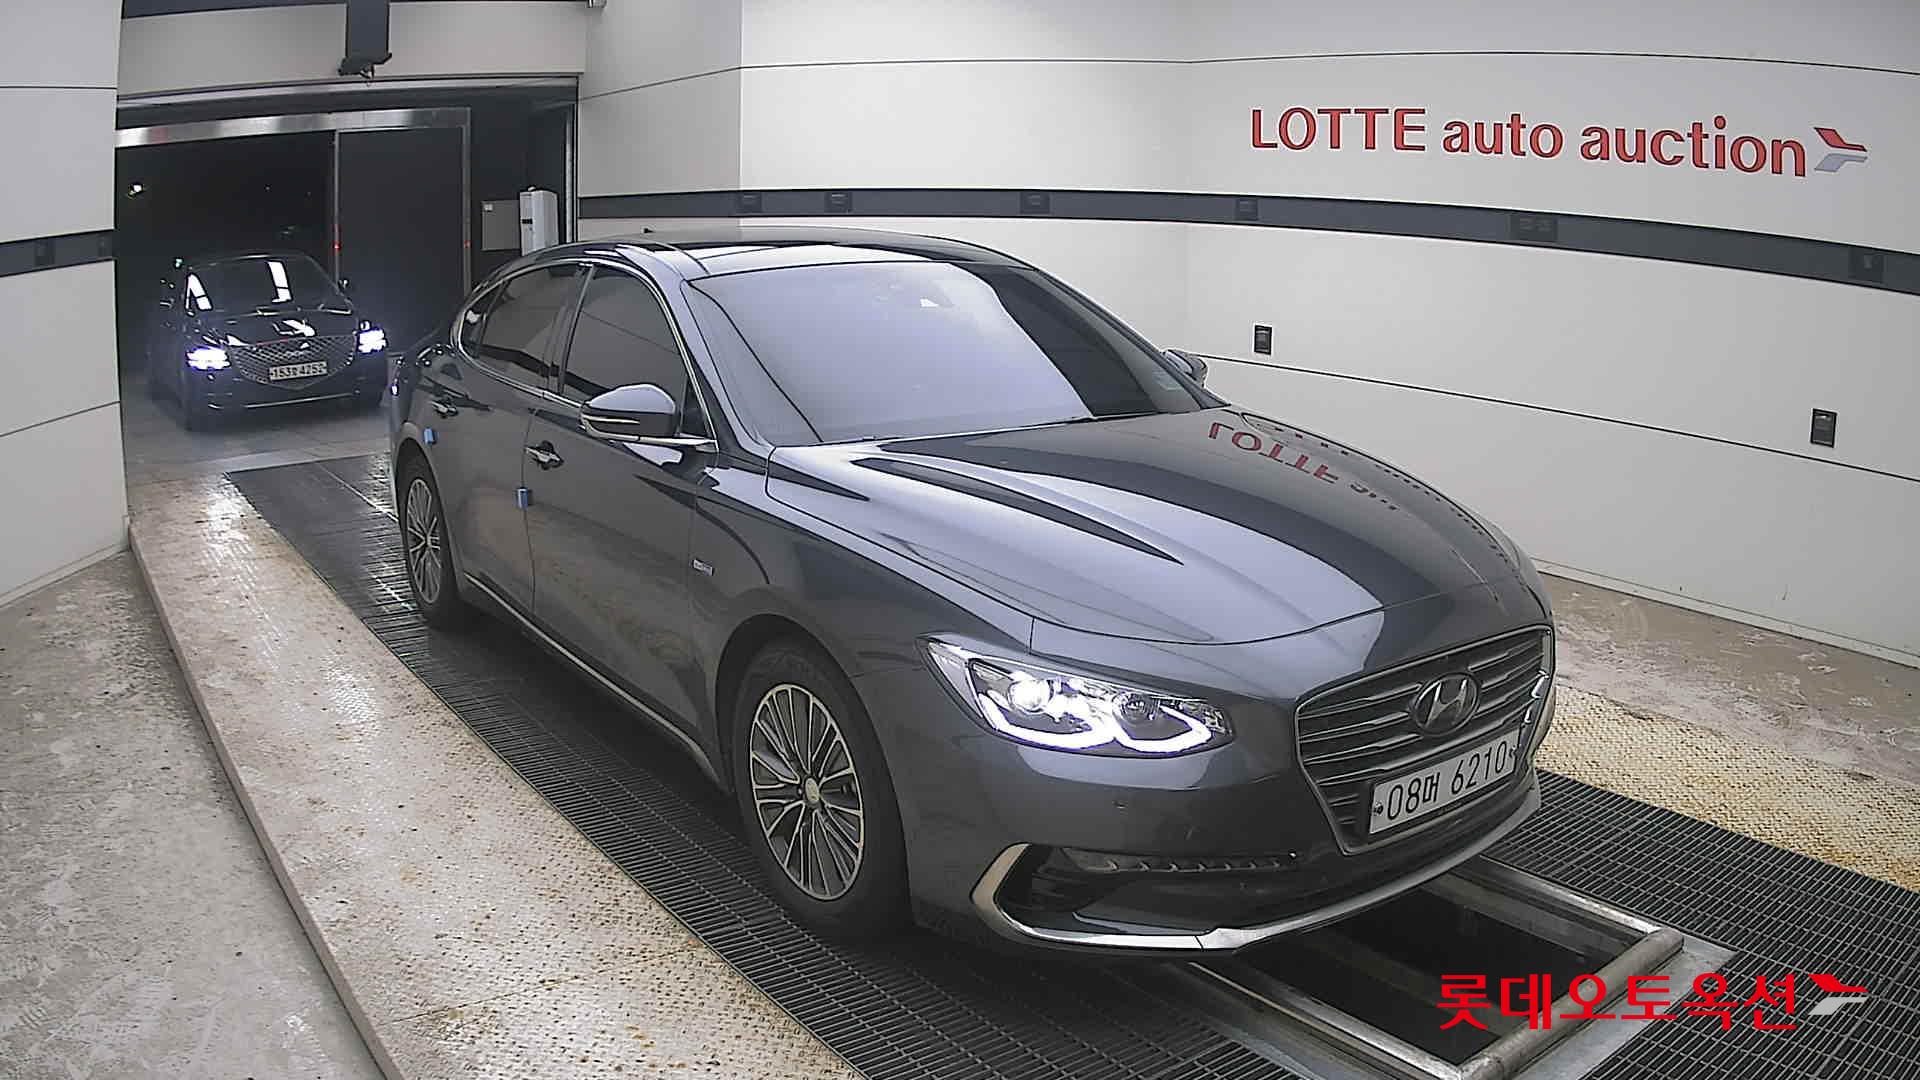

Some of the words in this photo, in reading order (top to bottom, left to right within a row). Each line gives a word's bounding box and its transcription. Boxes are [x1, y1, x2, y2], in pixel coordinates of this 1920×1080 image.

[1250, 107, 1427, 151] LOTTE
[1442, 113, 1564, 159] auto
[1580, 115, 1807, 178] auction
[1387, 772, 1440, 820] 08머
[1451, 741, 1507, 795] 6210
